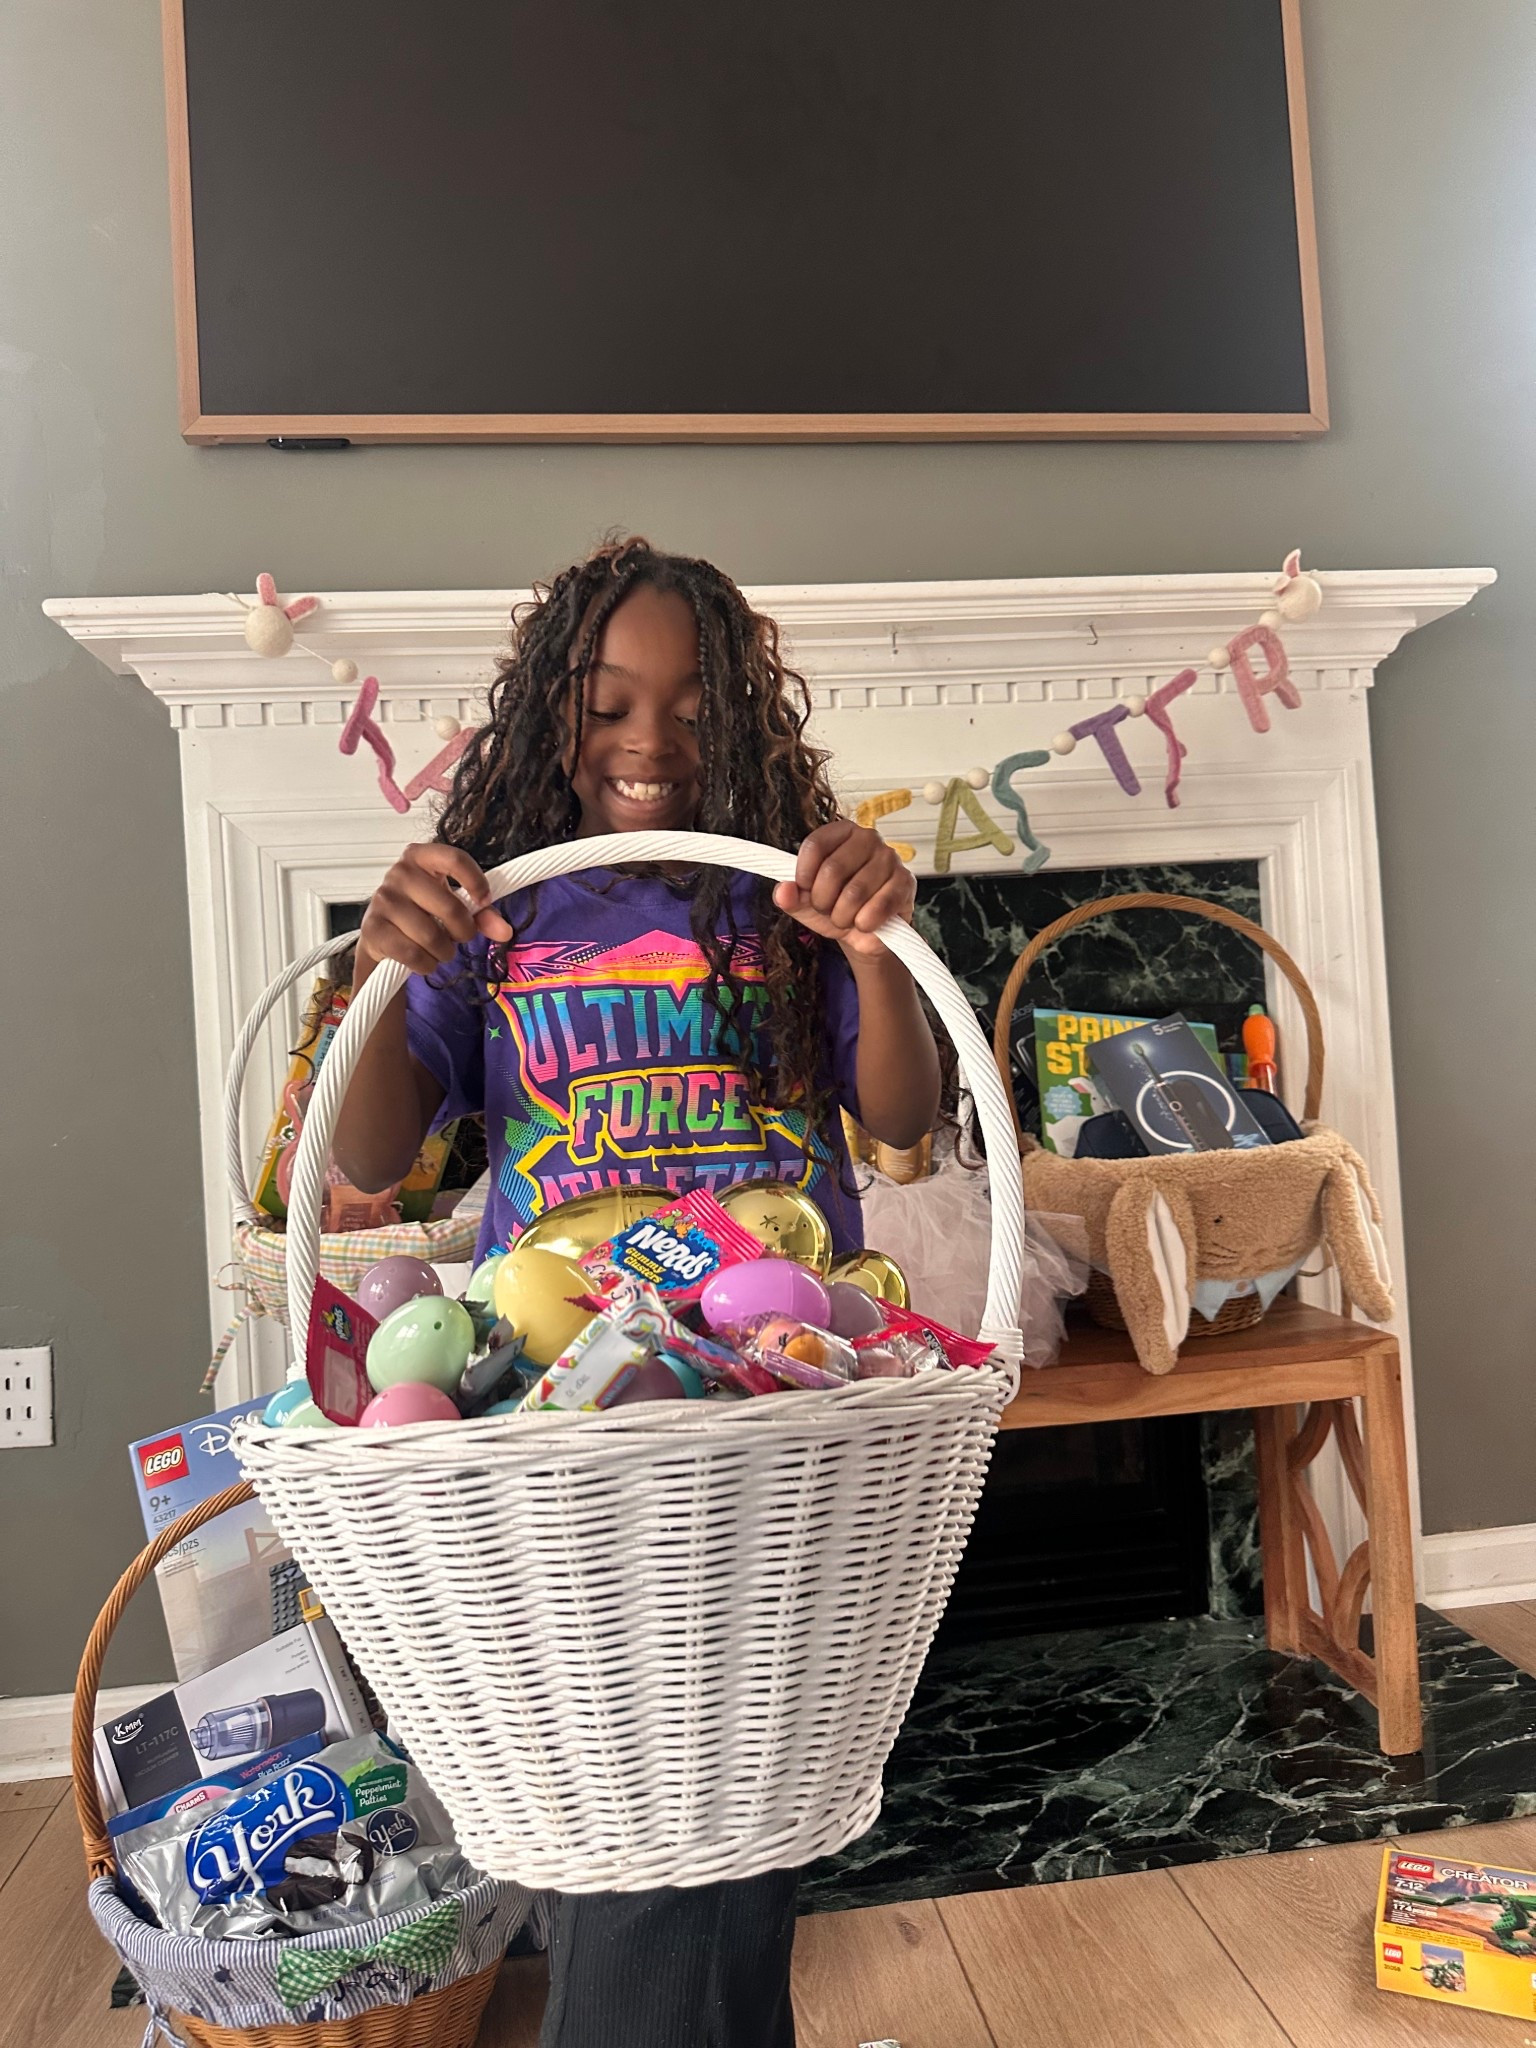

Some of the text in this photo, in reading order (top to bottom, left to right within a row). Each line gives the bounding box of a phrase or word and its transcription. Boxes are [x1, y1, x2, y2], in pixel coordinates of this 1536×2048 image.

[513, 985, 798, 1084] ULTIMAT
[1057, 1013, 1150, 1043] PAIN
[1151, 1023, 1165, 1036] 5
[573, 1070, 753, 1147] FORCE
[623, 1256, 663, 1284] Clusters
[625, 1247, 667, 1273] Gummy
[145, 1446, 183, 1476] LEGO
[149, 1495, 172, 1513] 9+
[114, 1719, 143, 1738] KMM
[135, 1726, 180, 1755] LT-117C
[240, 1751, 283, 1780] Watermelon
[175, 1791, 207, 1815] CHARMS
[355, 1778, 403, 1800] Peppermint
[359, 1793, 388, 1808] Patties
[193, 1765, 336, 1892] York
[369, 1811, 414, 1857] York
[1395, 1879, 1425, 1892] 7-12
[1399, 1860, 1432, 1873] LEGO
[1440, 1867, 1529, 1890] CREATOR
[1384, 1947, 1402, 1959] LEGO
